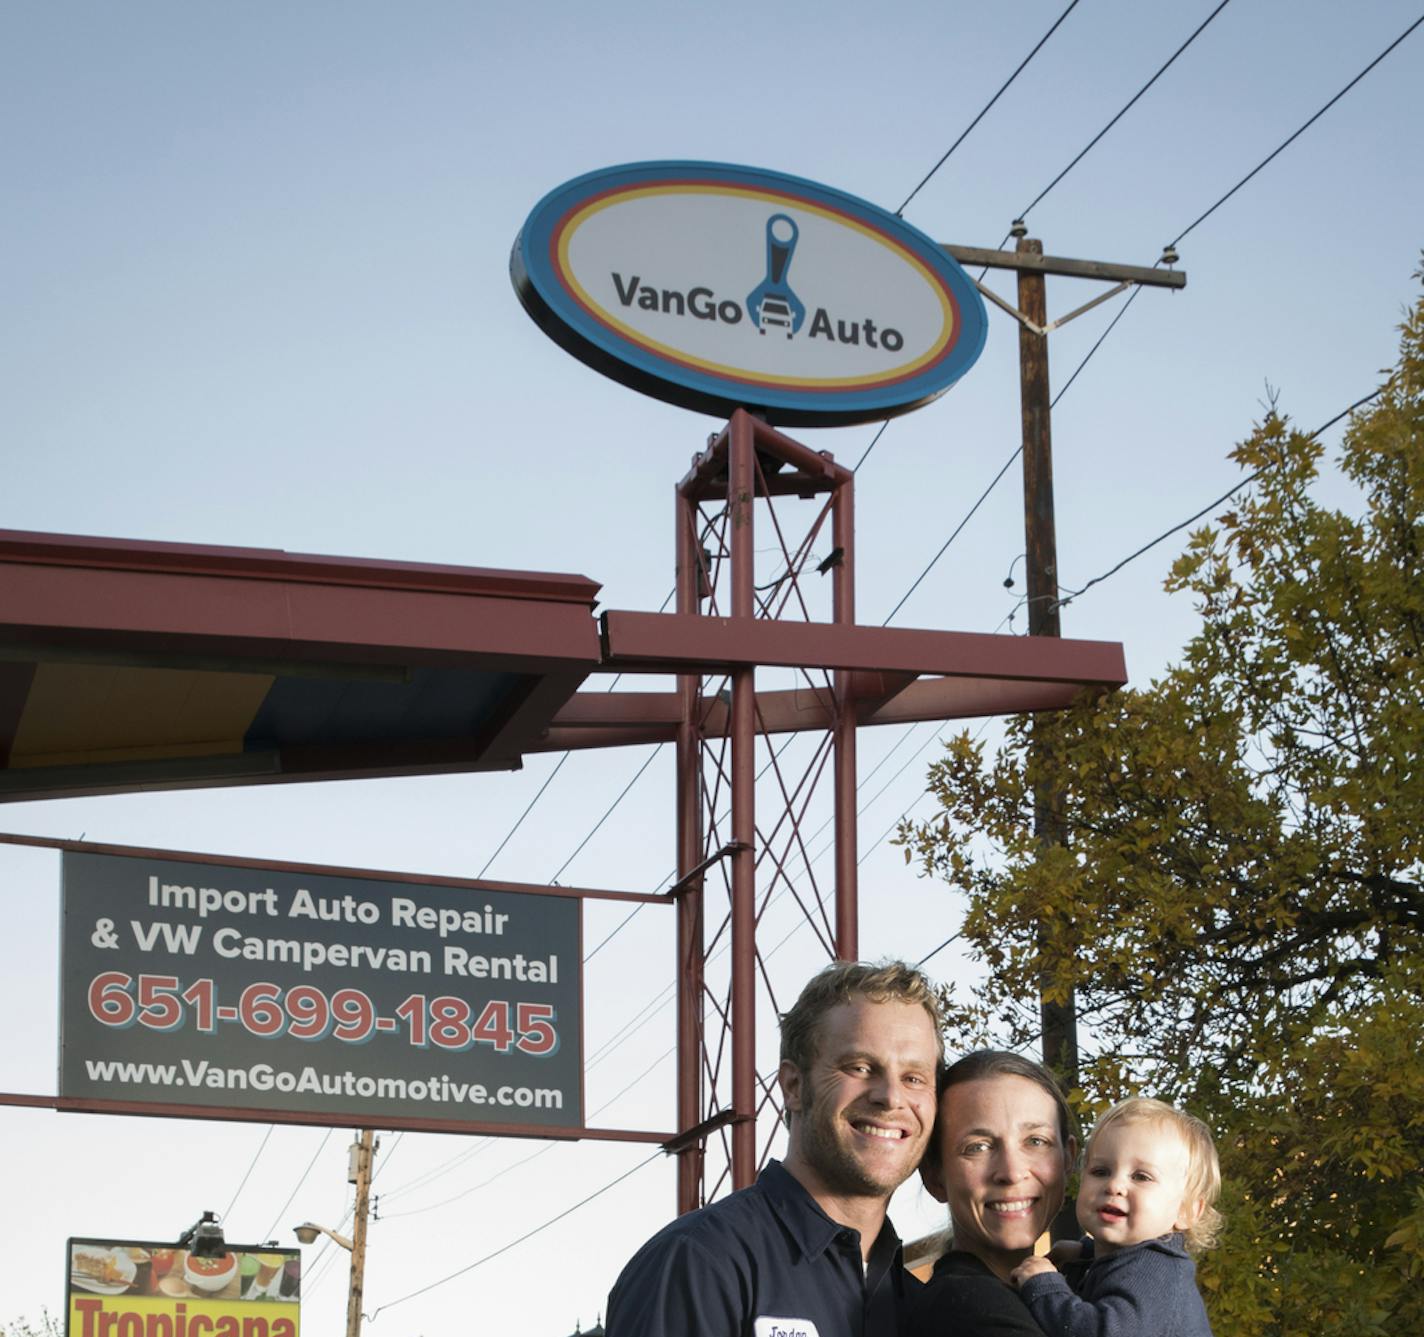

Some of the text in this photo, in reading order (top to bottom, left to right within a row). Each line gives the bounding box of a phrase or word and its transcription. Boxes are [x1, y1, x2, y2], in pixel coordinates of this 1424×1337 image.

[611, 272, 905, 353] VanGo Auto
[149, 875, 509, 937] Import Auto Repair
[90, 917, 558, 984] & VW Campervan Rental
[87, 971, 559, 1058] 651-699-1845
[85, 1059, 563, 1109] www.VanGoAutomotive.com
